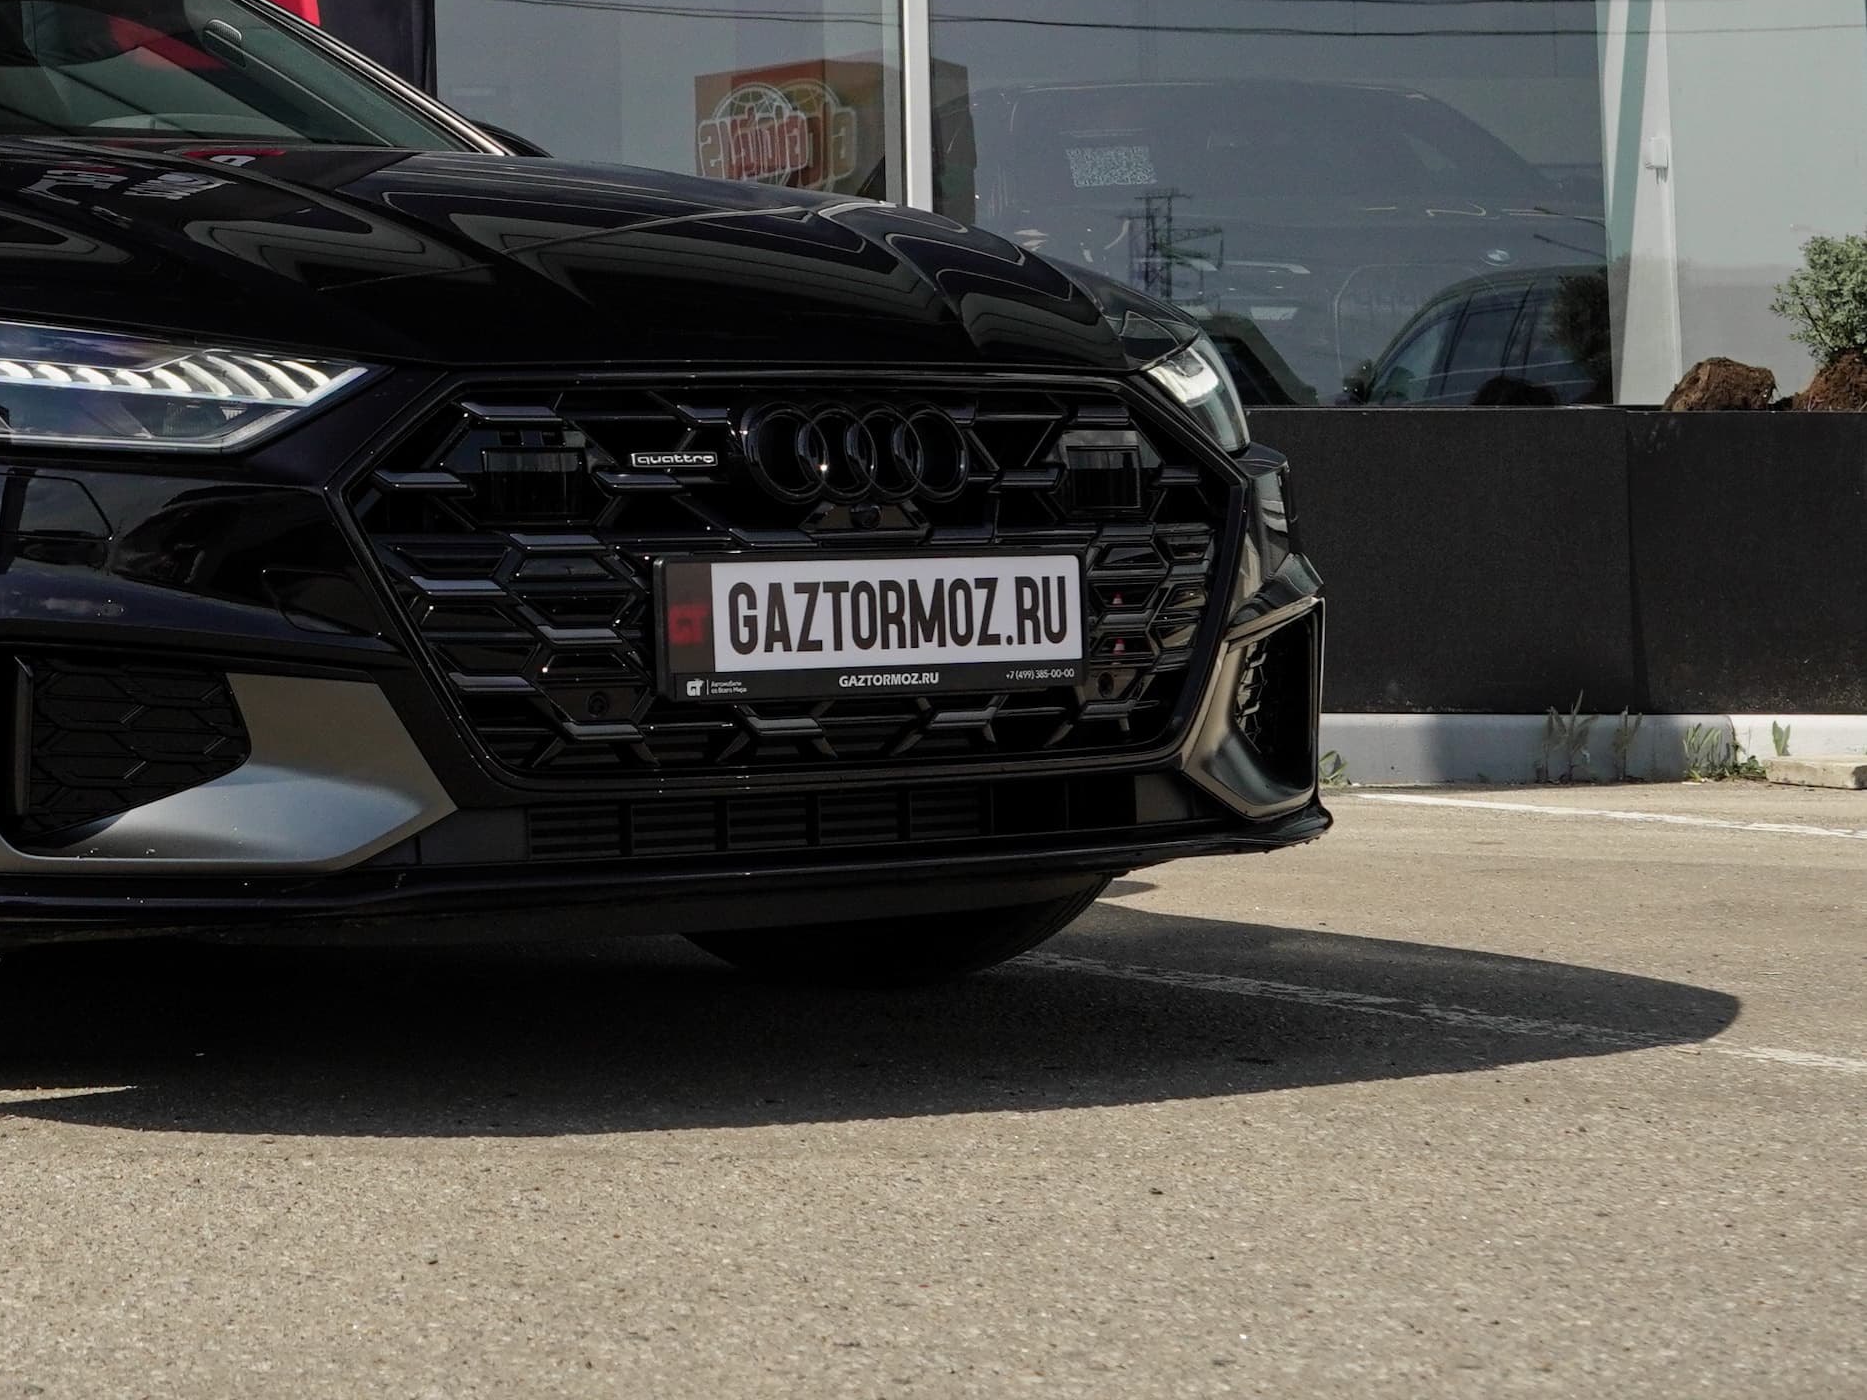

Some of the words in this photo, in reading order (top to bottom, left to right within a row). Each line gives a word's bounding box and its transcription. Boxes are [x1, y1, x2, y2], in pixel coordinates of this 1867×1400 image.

[637, 454, 714, 465] quattro
[728, 576, 1068, 656] GAZTORMOZ.RU
[838, 671, 939, 688] GAZTORMOZ.RU
